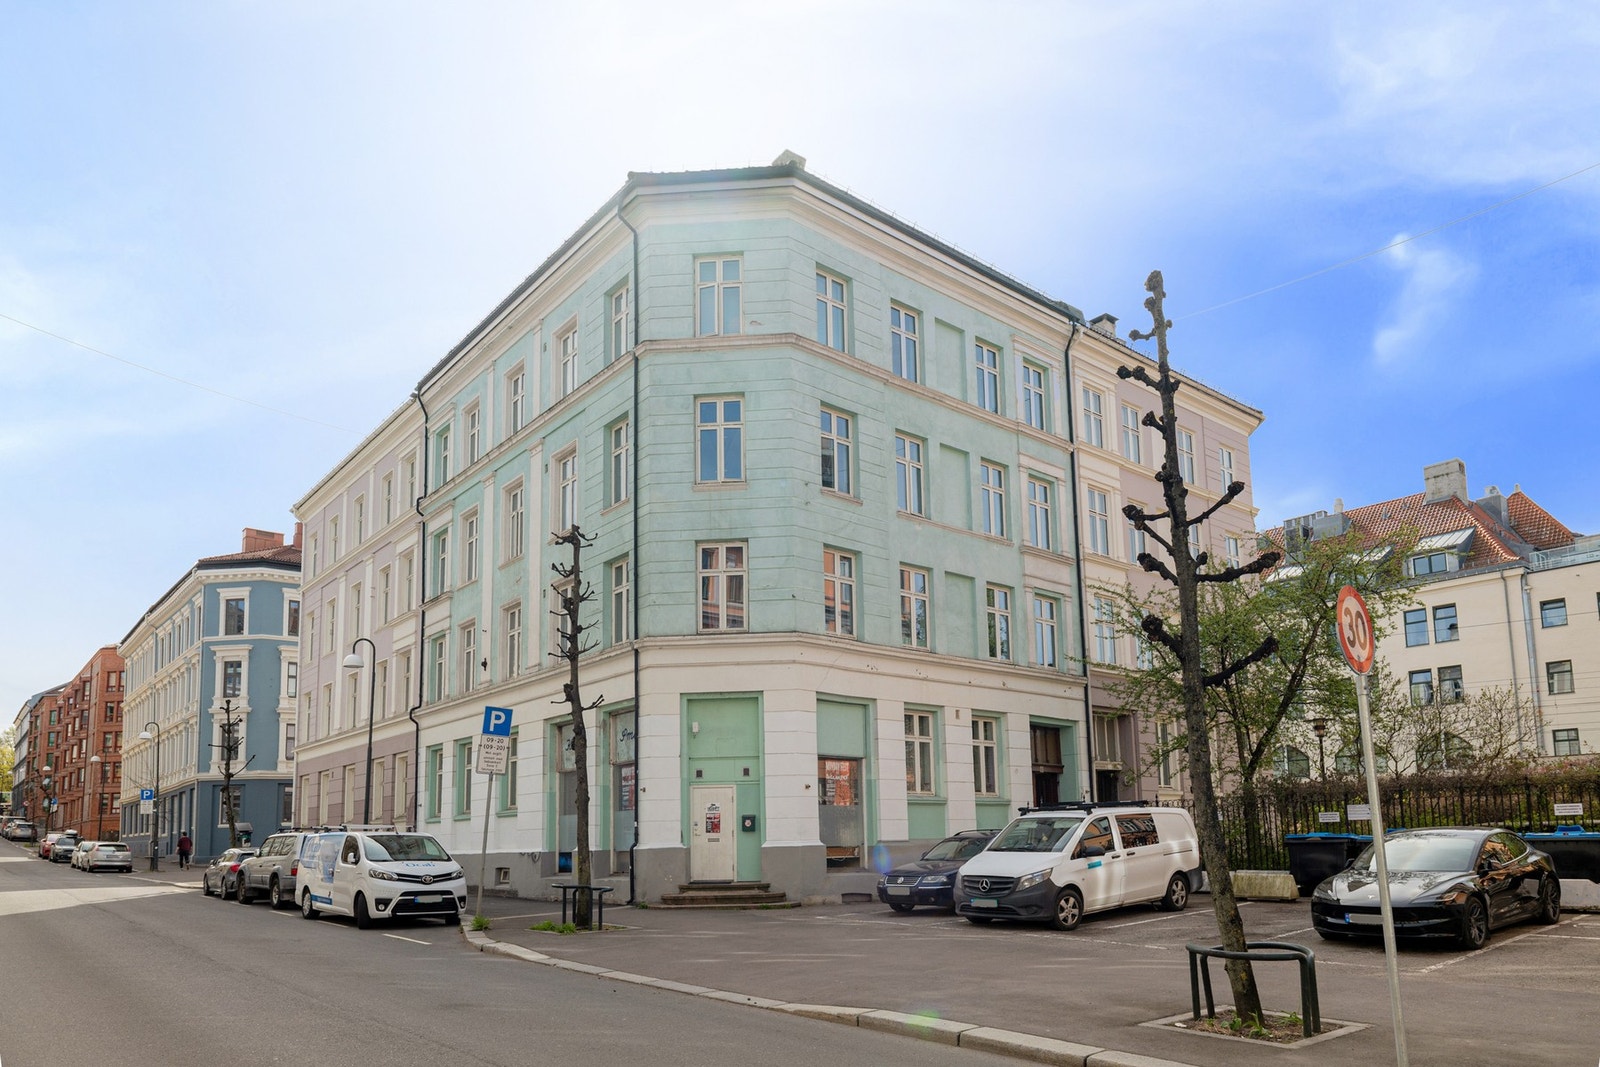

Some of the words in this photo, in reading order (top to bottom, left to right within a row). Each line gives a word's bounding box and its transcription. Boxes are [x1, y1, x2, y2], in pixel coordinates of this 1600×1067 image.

[1343, 606, 1368, 651] 30
[489, 710, 506, 732] P
[143, 790, 151, 799] P
